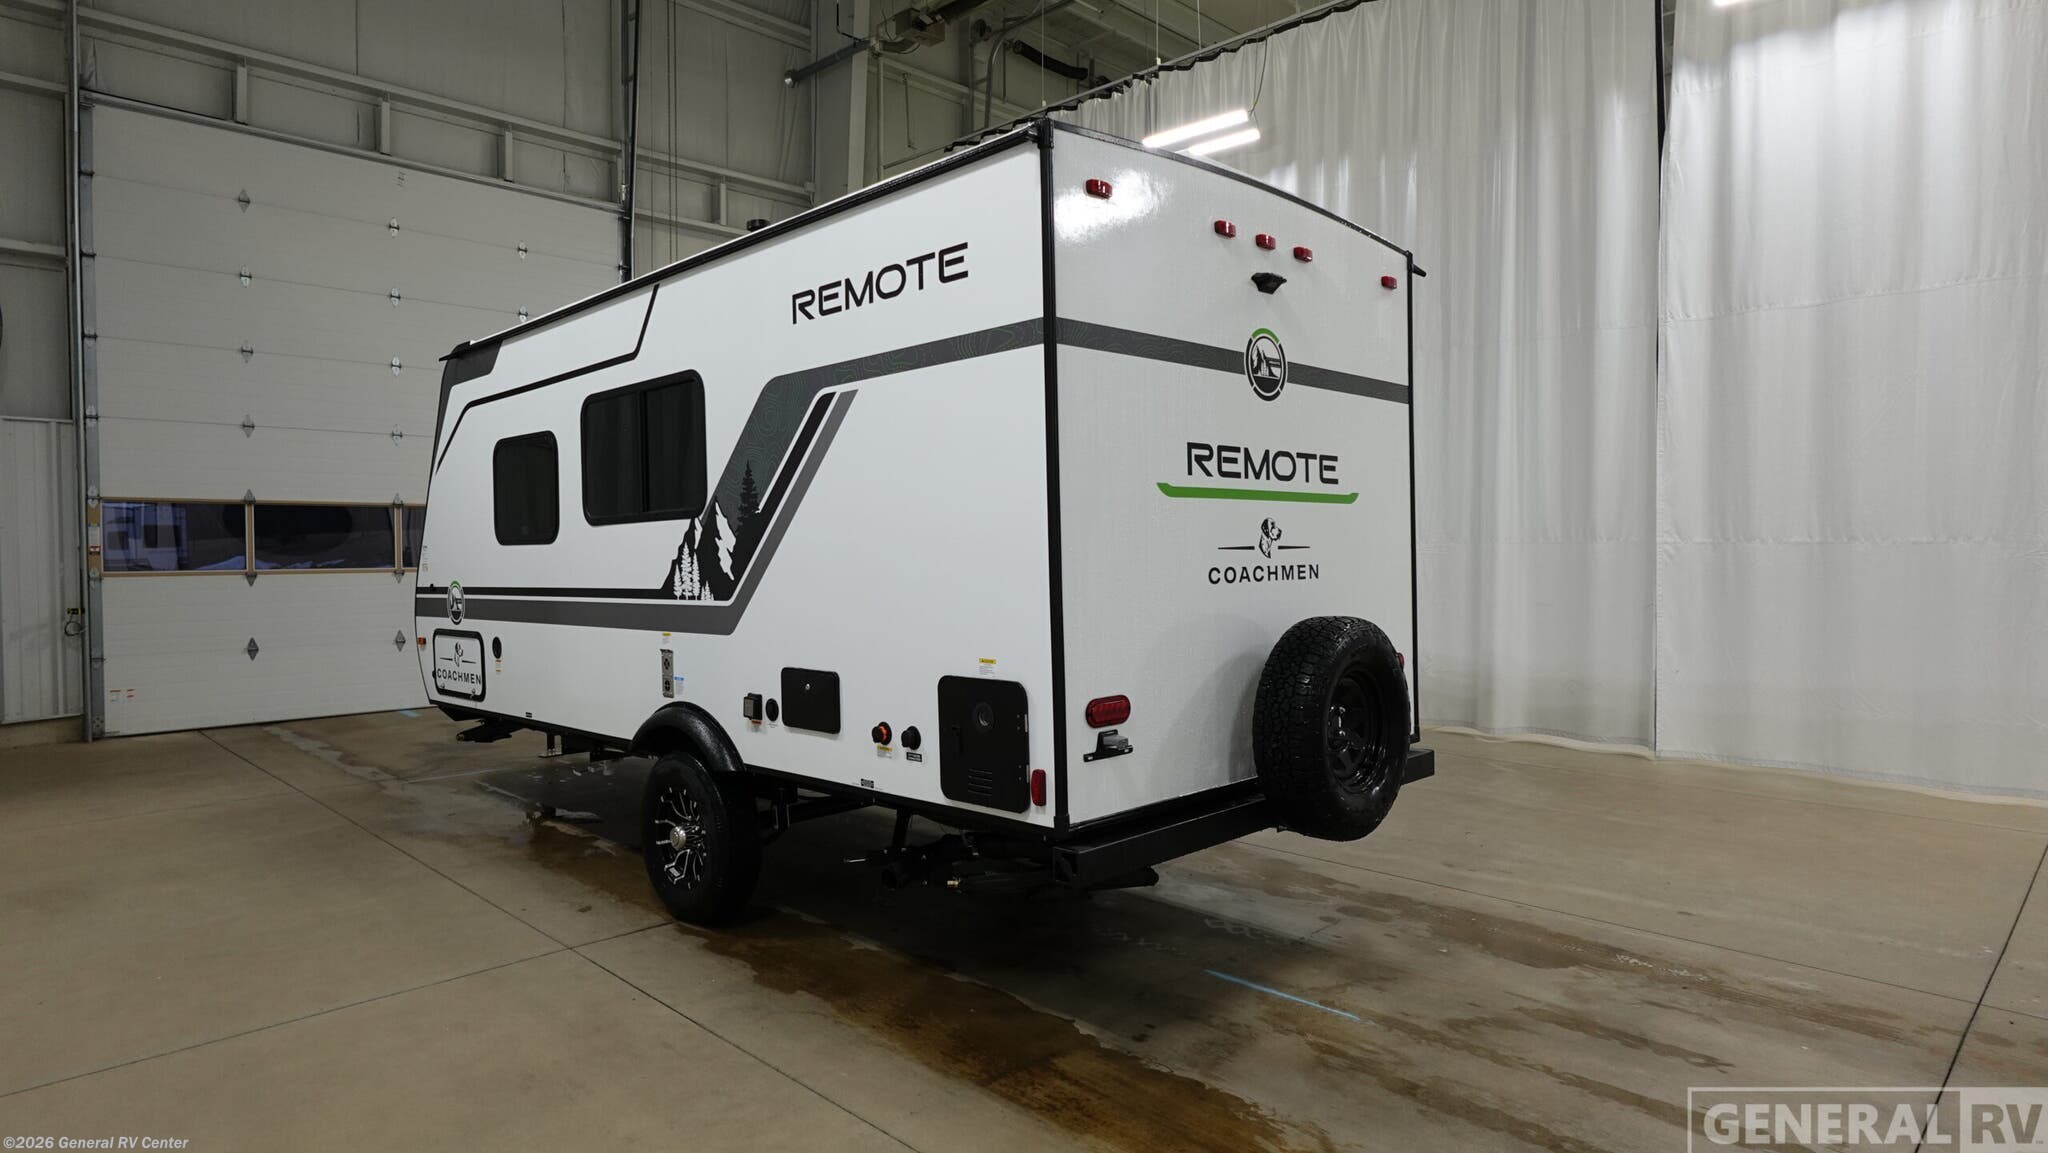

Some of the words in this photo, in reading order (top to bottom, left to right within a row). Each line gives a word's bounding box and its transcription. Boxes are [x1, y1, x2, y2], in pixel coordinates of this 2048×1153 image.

[792, 242, 968, 324] REMOTE
[1187, 442, 1339, 485] REMOTE
[1208, 564, 1320, 584] COACHMEN
[436, 668, 482, 685] COACHMEN
